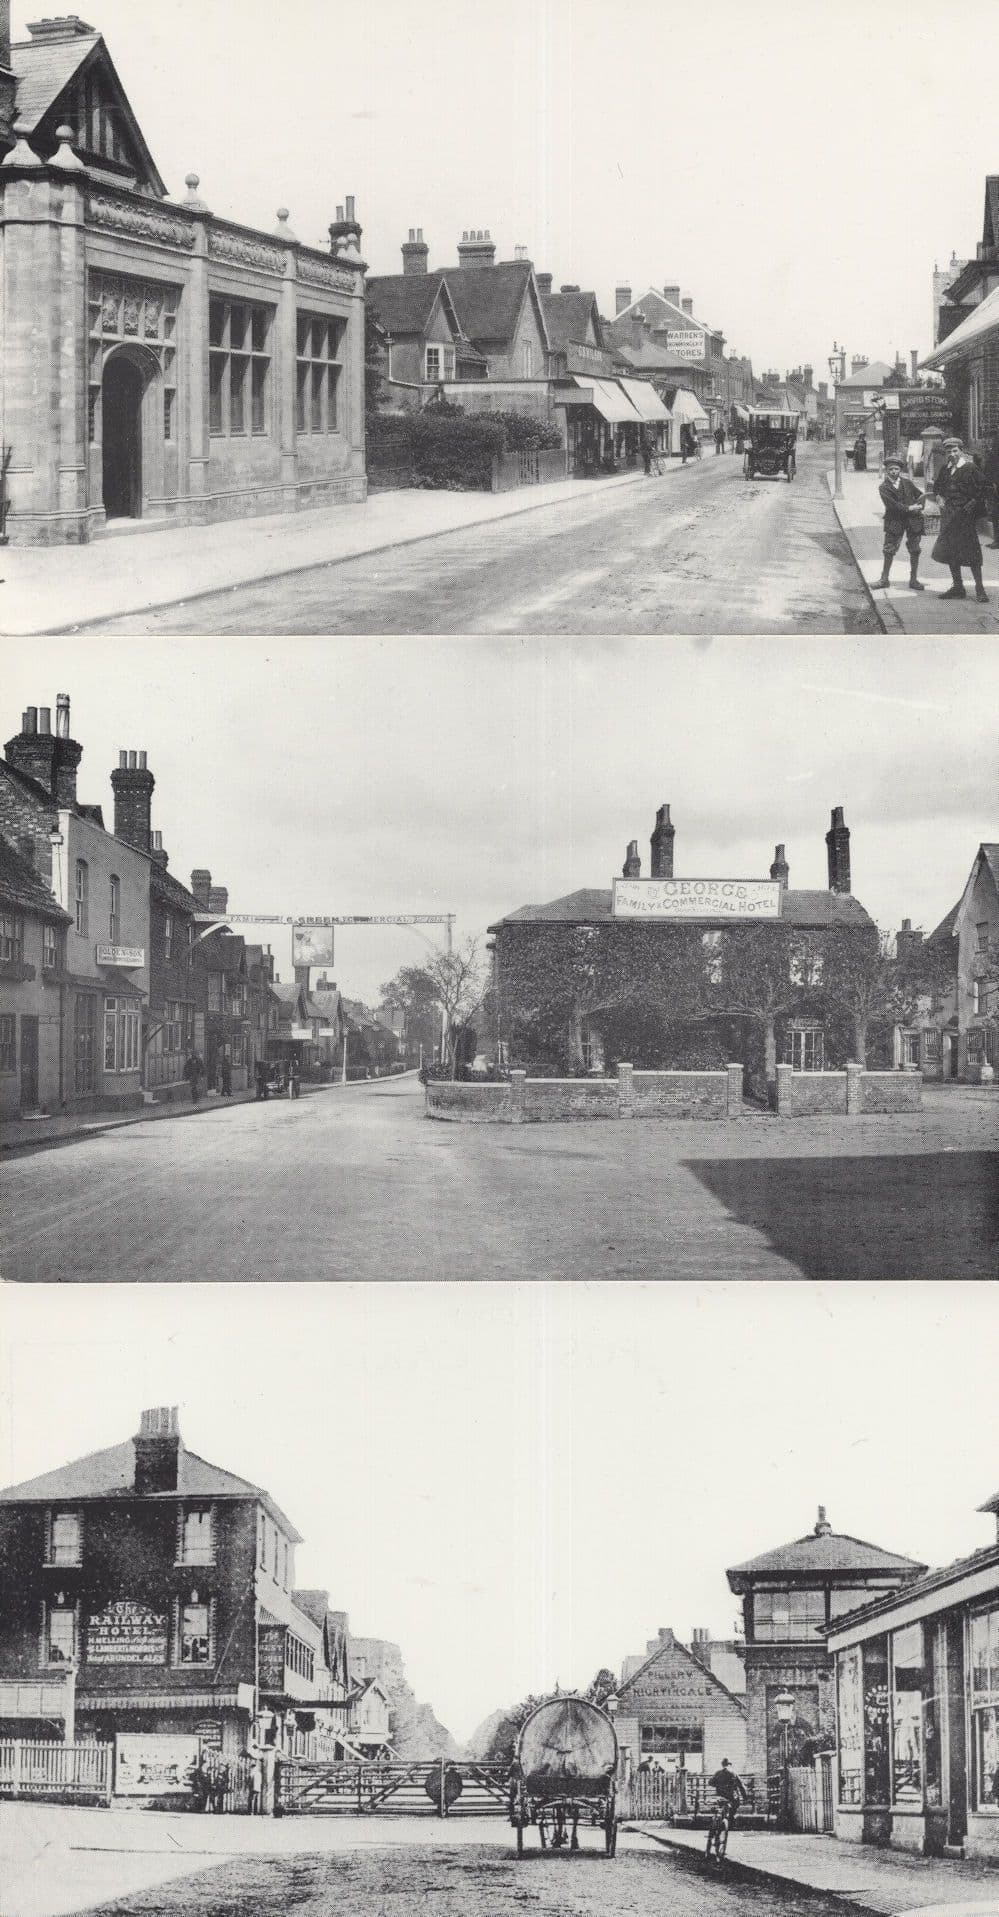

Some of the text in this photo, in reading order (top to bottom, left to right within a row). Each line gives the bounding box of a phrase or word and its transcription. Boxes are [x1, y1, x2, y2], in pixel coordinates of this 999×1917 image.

[664, 881, 748, 899] GEORGE
[616, 895, 656, 911] FAMILY
[662, 896, 736, 912] COMMERCIAL
[738, 899, 777, 912] HOTEL
[90, 1615, 165, 1626] RAILWAY
[99, 1627, 152, 1636] HOTEL
